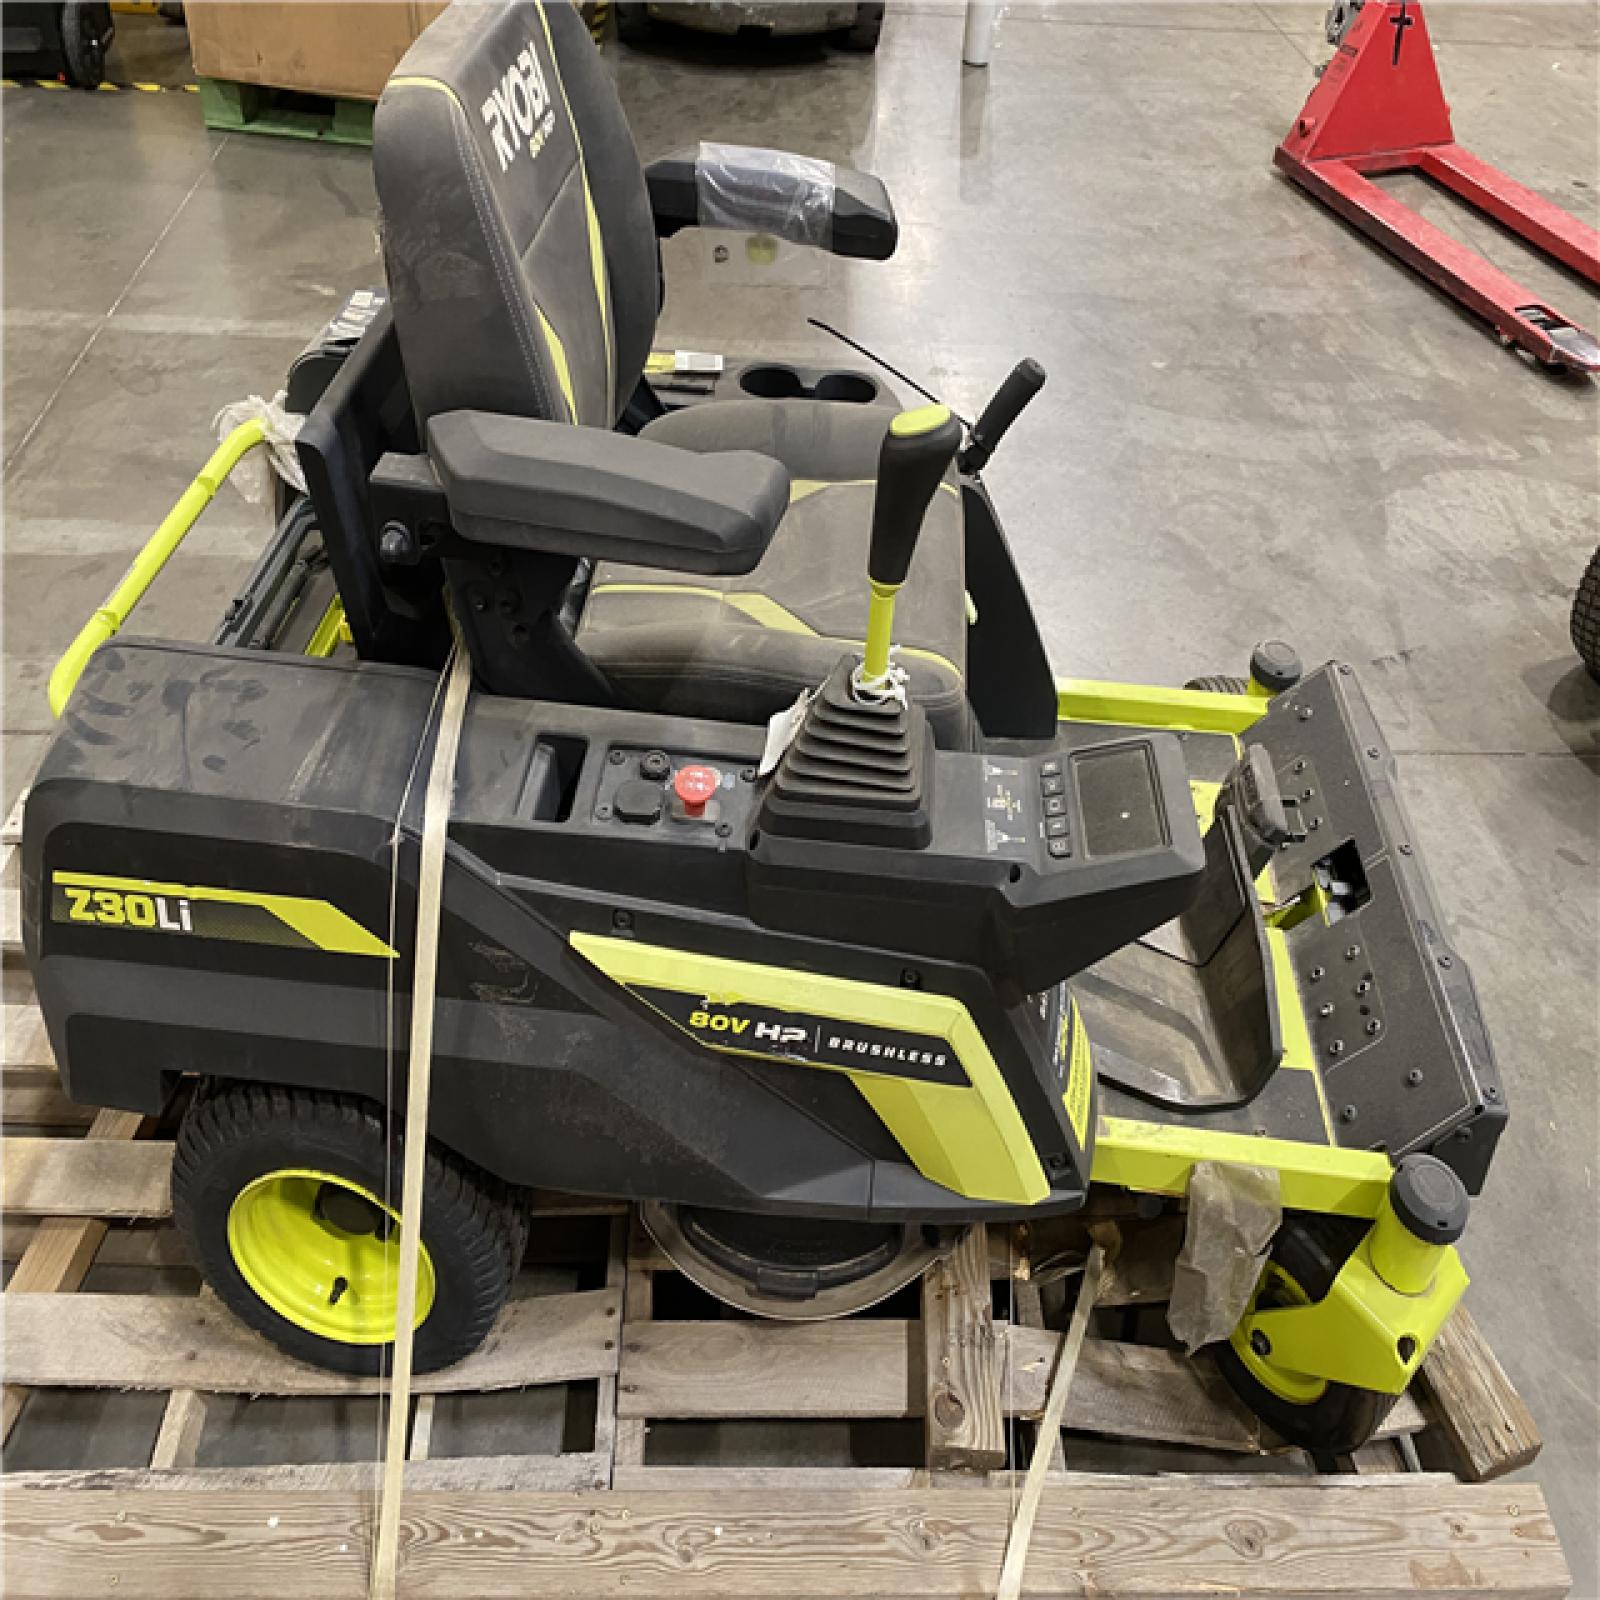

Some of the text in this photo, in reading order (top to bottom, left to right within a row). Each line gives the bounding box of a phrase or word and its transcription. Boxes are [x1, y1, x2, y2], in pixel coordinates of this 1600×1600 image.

[481, 40, 550, 168] RYOBI
[65, 887, 192, 931] Z30Li
[689, 1011, 946, 1066] 80V HP BRUSHLESS
